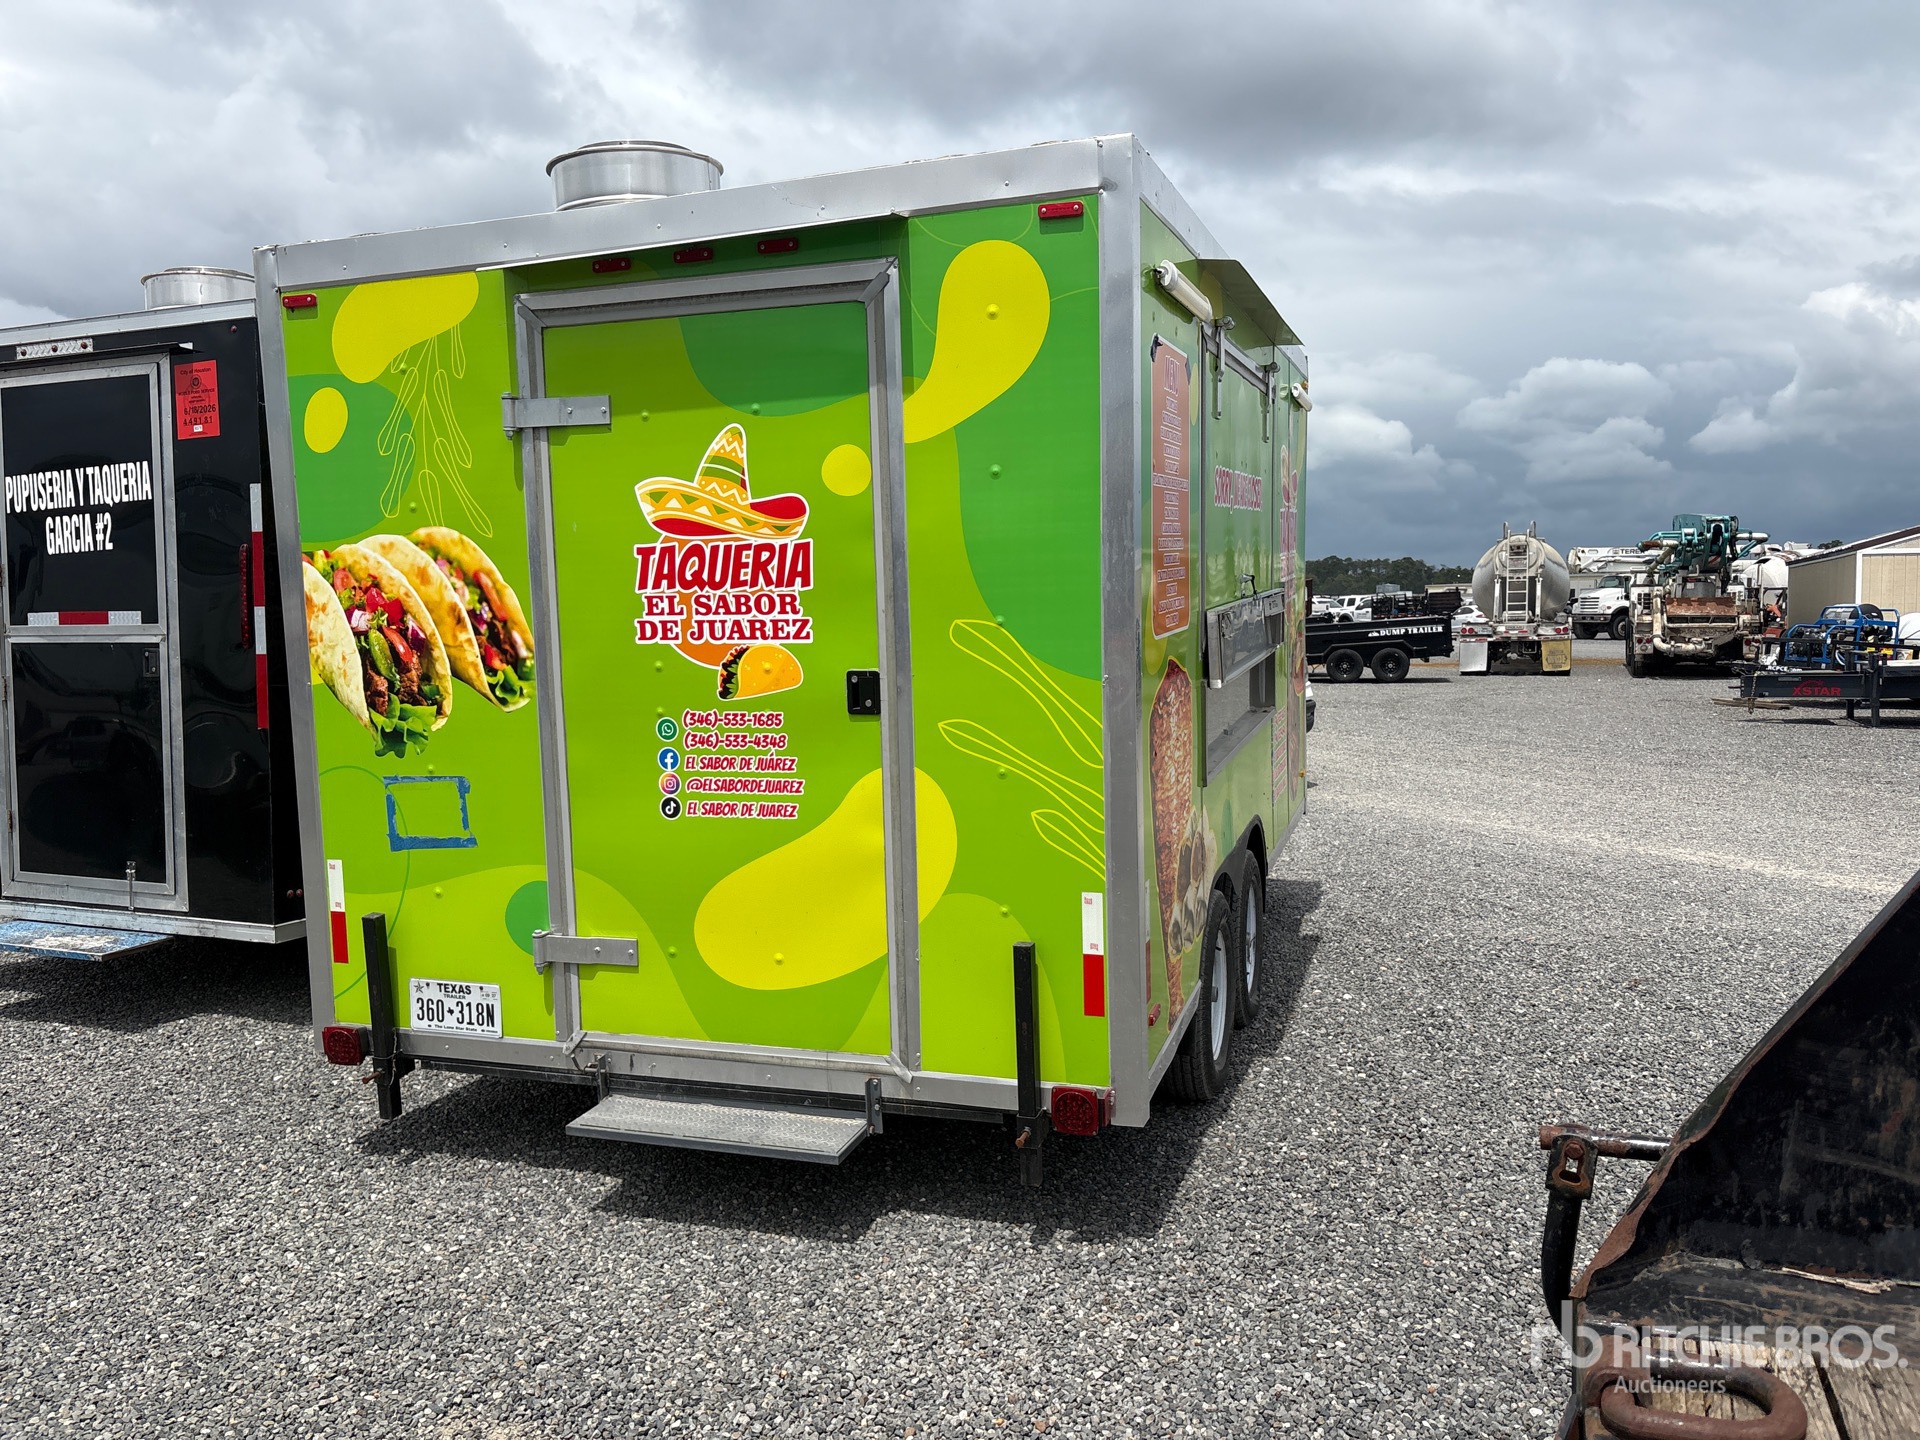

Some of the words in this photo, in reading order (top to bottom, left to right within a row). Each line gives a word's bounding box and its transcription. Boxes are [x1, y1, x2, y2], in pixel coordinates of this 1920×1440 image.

[5, 469, 75, 514] PUPUSERIA
[75, 468, 85, 507] Y
[86, 460, 152, 506] TAQUERIA
[45, 513, 94, 555] GARCIA
[95, 512, 114, 551] #2
[635, 540, 812, 593] TAQUERIA
[644, 594, 684, 616] EL
[693, 592, 801, 616] SABOR
[636, 619, 680, 641] DE
[689, 618, 812, 641] JUAREZ
[1380, 628, 1406, 636] DUMP
[1407, 626, 1443, 635] TRAILER
[1792, 687, 1841, 696] XSTAR
[683, 709, 783, 729] (346)-533-1685
[684, 731, 787, 750] (346)-533-4348
[685, 756, 697, 771] EL
[699, 756, 737, 772] SABOR
[739, 757, 753, 771] DE
[755, 752, 797, 772] JUÁREZ
[686, 777, 804, 794] @ELSABORDEJUAREZ
[687, 802, 698, 816] EL
[701, 802, 739, 817] SABOR
[741, 803, 755, 818] DE
[757, 803, 798, 819] JUAREZ
[437, 983, 472, 995] TEXAS
[416, 997, 445, 1023] 360
[456, 1000, 495, 1028] 318N
